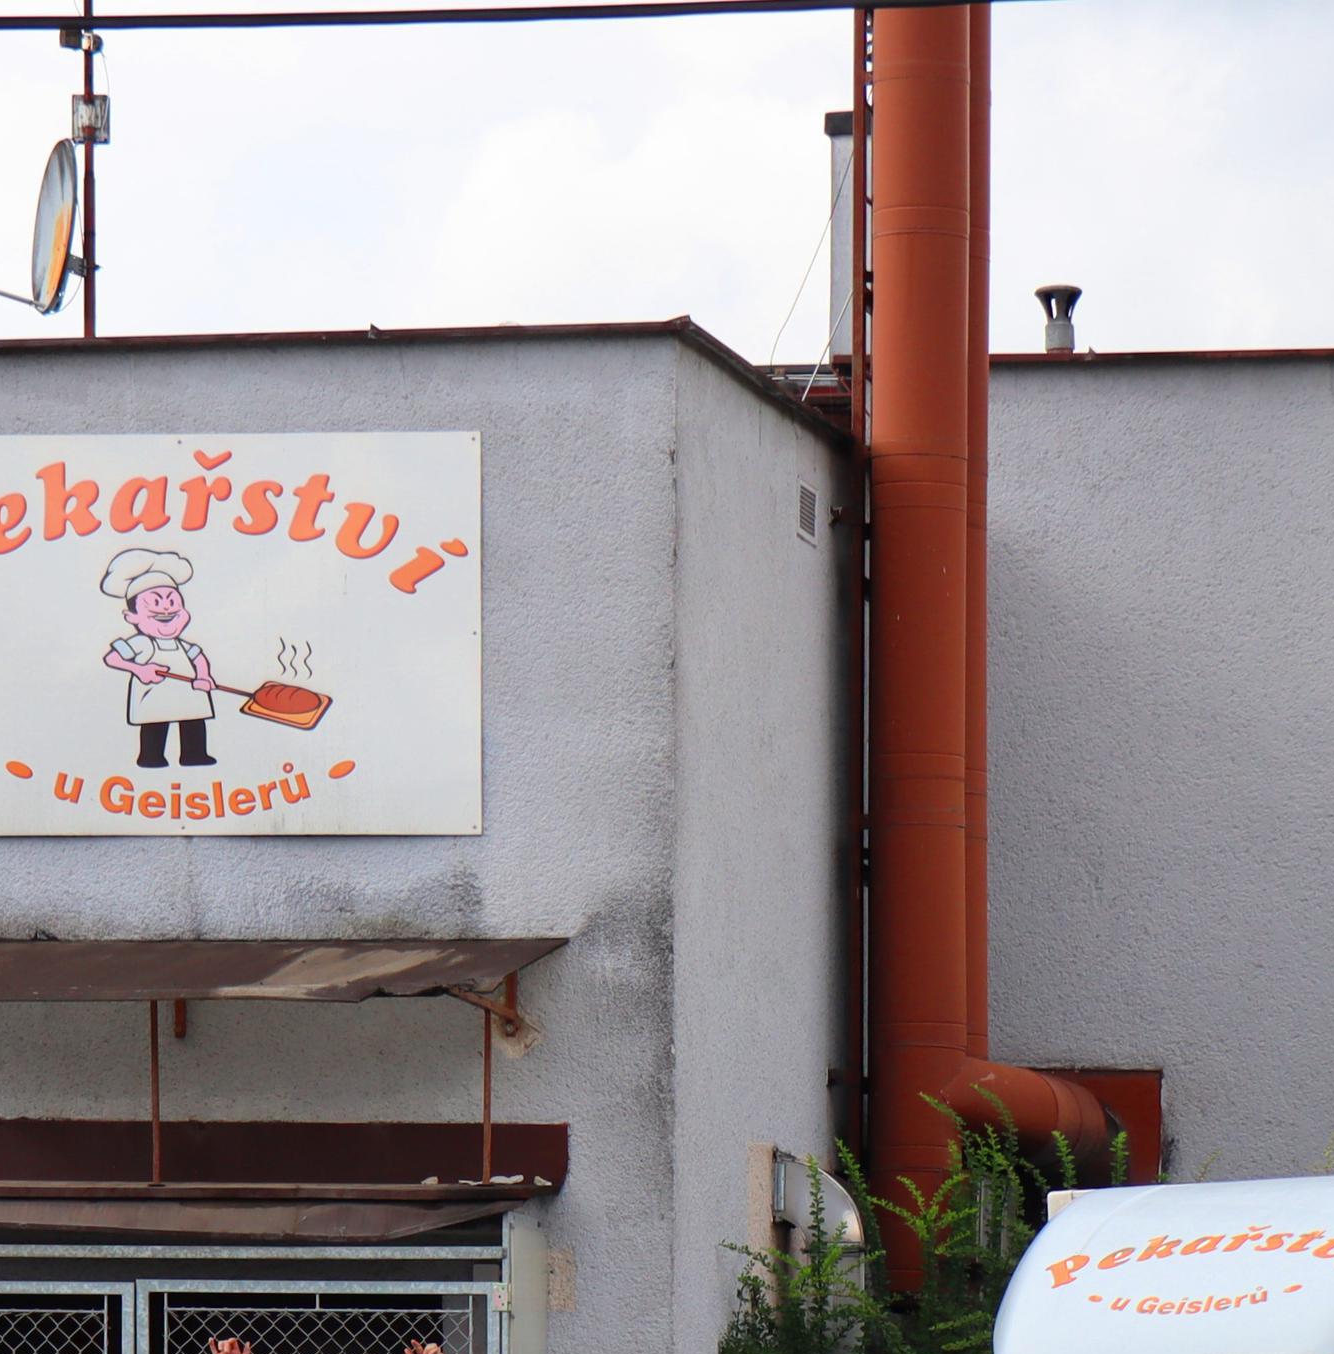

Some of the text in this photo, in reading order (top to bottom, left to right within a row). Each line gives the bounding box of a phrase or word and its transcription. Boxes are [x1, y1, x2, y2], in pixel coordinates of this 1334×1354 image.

[53, 763, 311, 821] u Geislerů
[1110, 1285, 1268, 1316] u Geislerů
